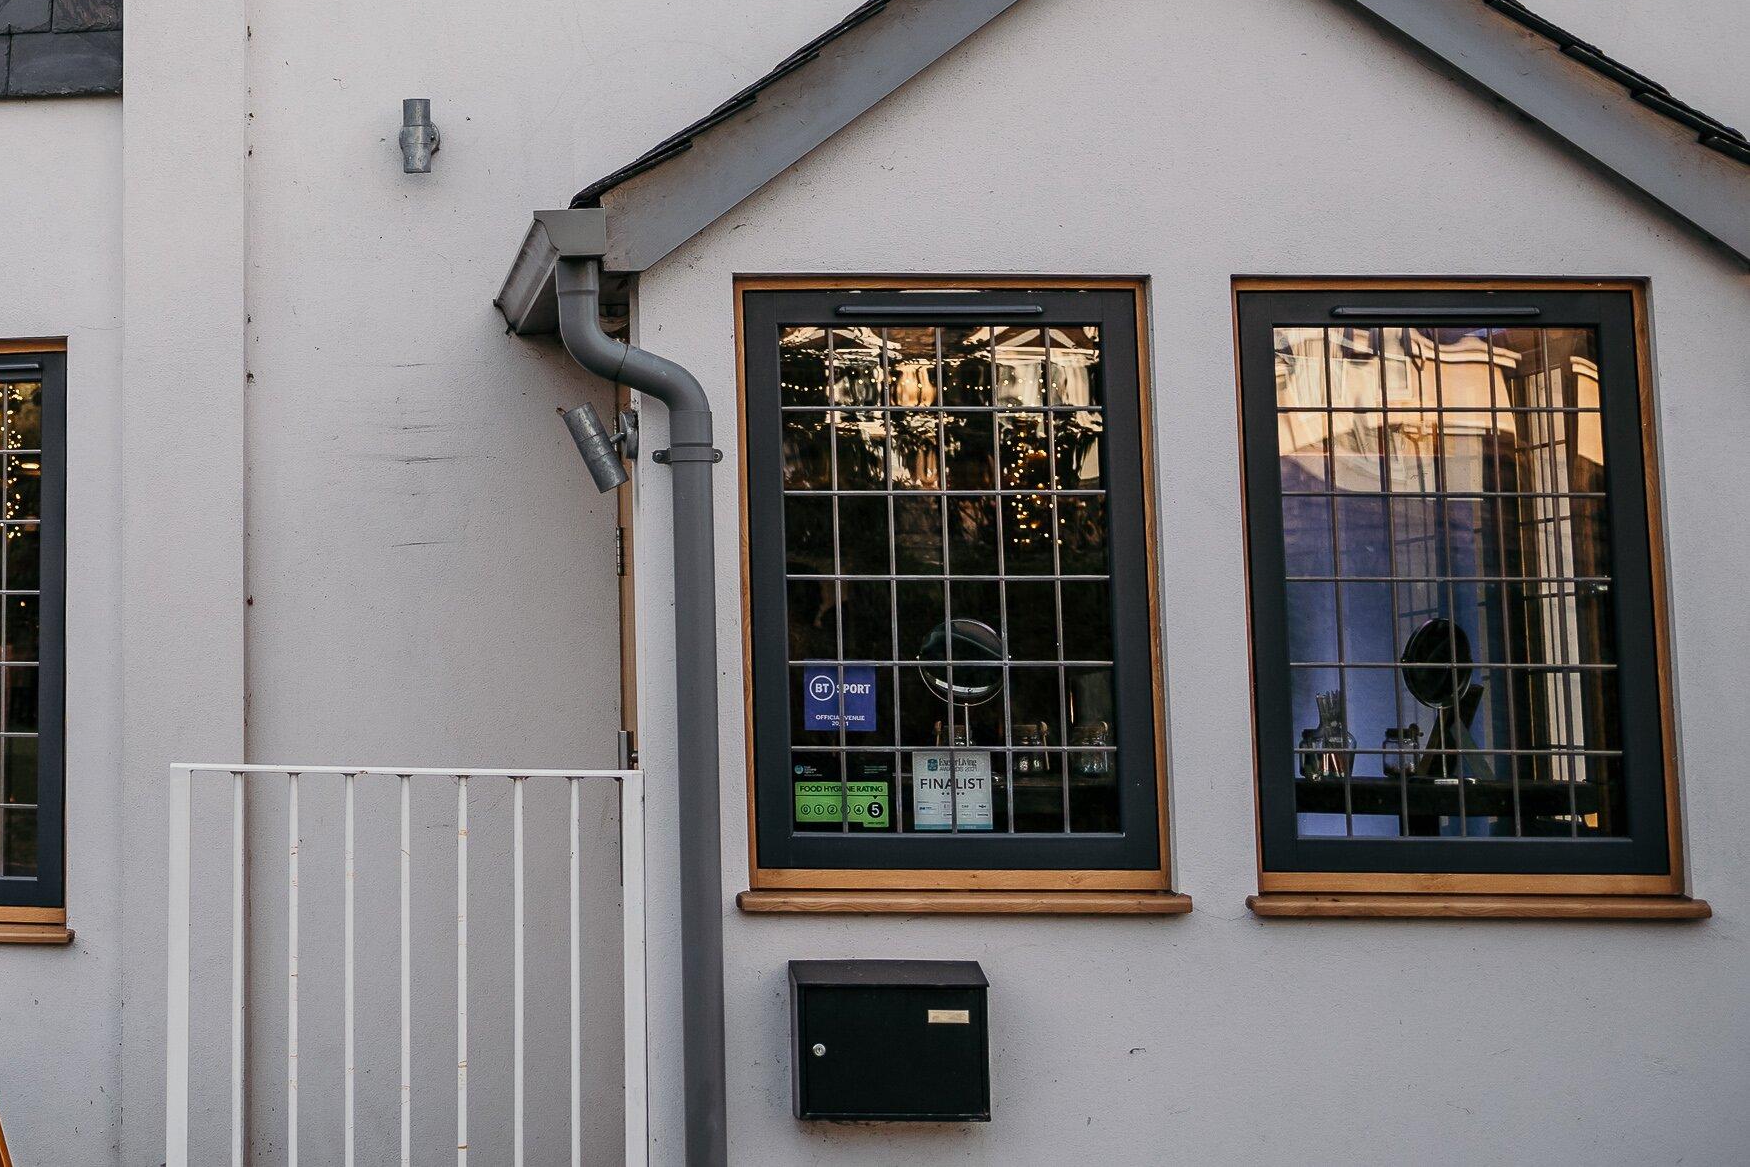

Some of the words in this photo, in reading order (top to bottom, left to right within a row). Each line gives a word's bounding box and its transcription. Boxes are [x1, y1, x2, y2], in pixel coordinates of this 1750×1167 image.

[815, 683, 830, 693] BT
[799, 785, 823, 793] FOOD
[823, 785, 856, 793] HYGINE
[856, 785, 884, 793] RATING
[870, 804, 880, 816] 5
